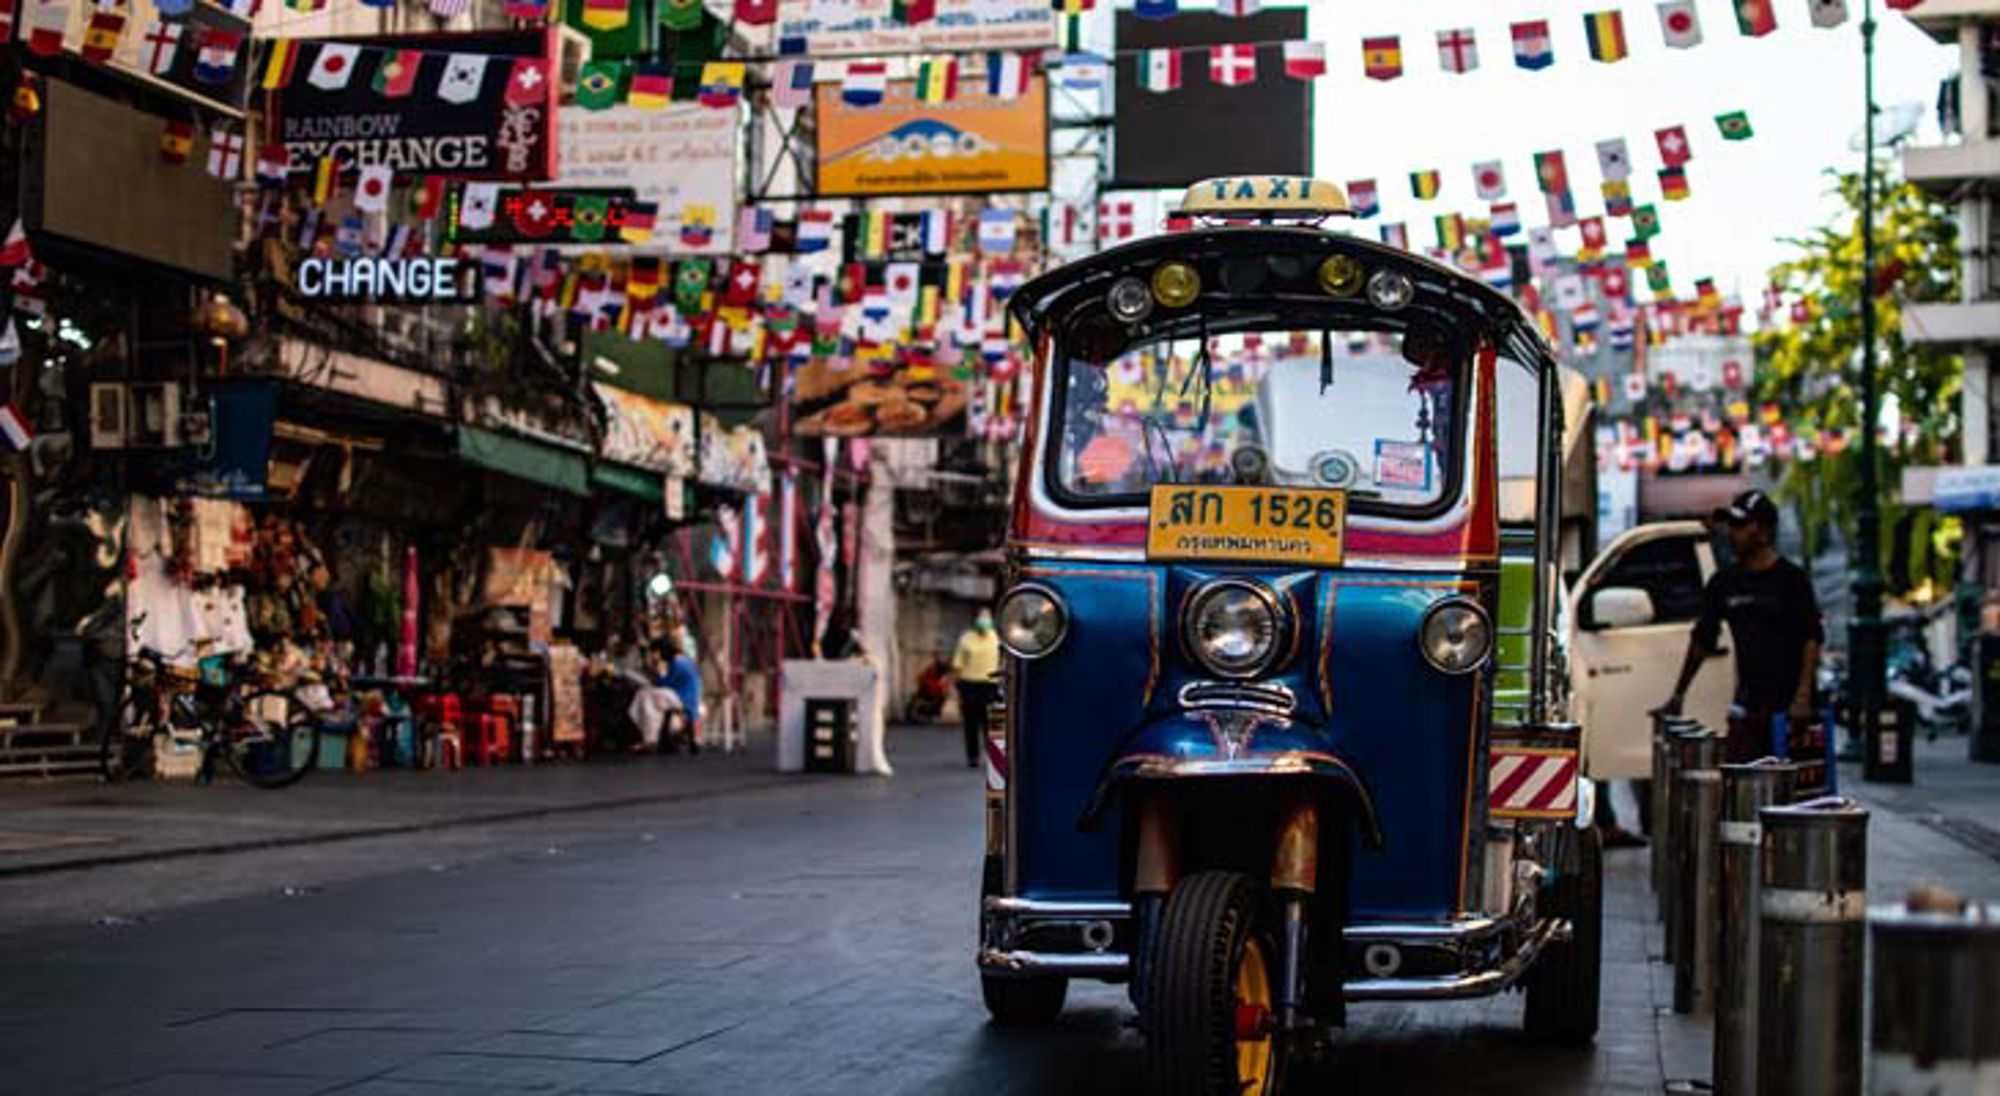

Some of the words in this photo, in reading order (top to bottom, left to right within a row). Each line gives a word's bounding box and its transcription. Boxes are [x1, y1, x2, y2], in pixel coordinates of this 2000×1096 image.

[285, 114, 400, 138] RAINBOW
[1212, 179, 1312, 200] TAXI
[299, 258, 459, 297] CHANGE
[1170, 490, 1223, 525] สก
[1250, 494, 1336, 530] 1526
